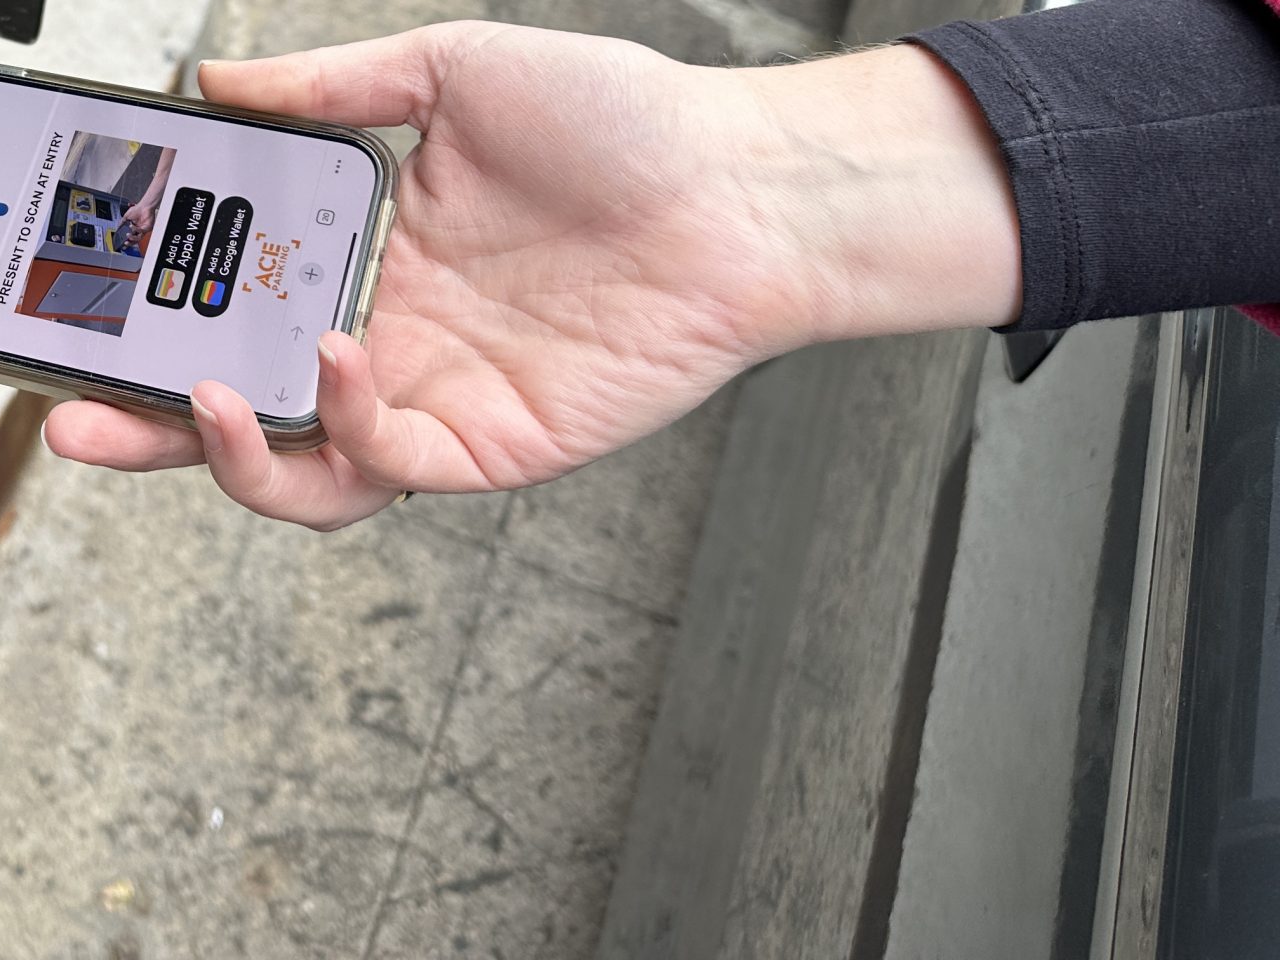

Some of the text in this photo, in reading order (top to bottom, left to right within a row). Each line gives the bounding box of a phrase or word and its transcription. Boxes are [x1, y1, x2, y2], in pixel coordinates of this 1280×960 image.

[42, 131, 64, 171] ENTRY
[37, 173, 50, 190] AT
[24, 190, 44, 225] SCAN
[18, 226, 32, 247] TO
[165, 234, 182, 265] Add to
[177, 196, 207, 268] Apple Wallet
[220, 208, 246, 276] Google Wallet
[208, 247, 222, 274] Add to
[254, 242, 281, 289] ACE
[272, 246, 290, 291] PARKING
